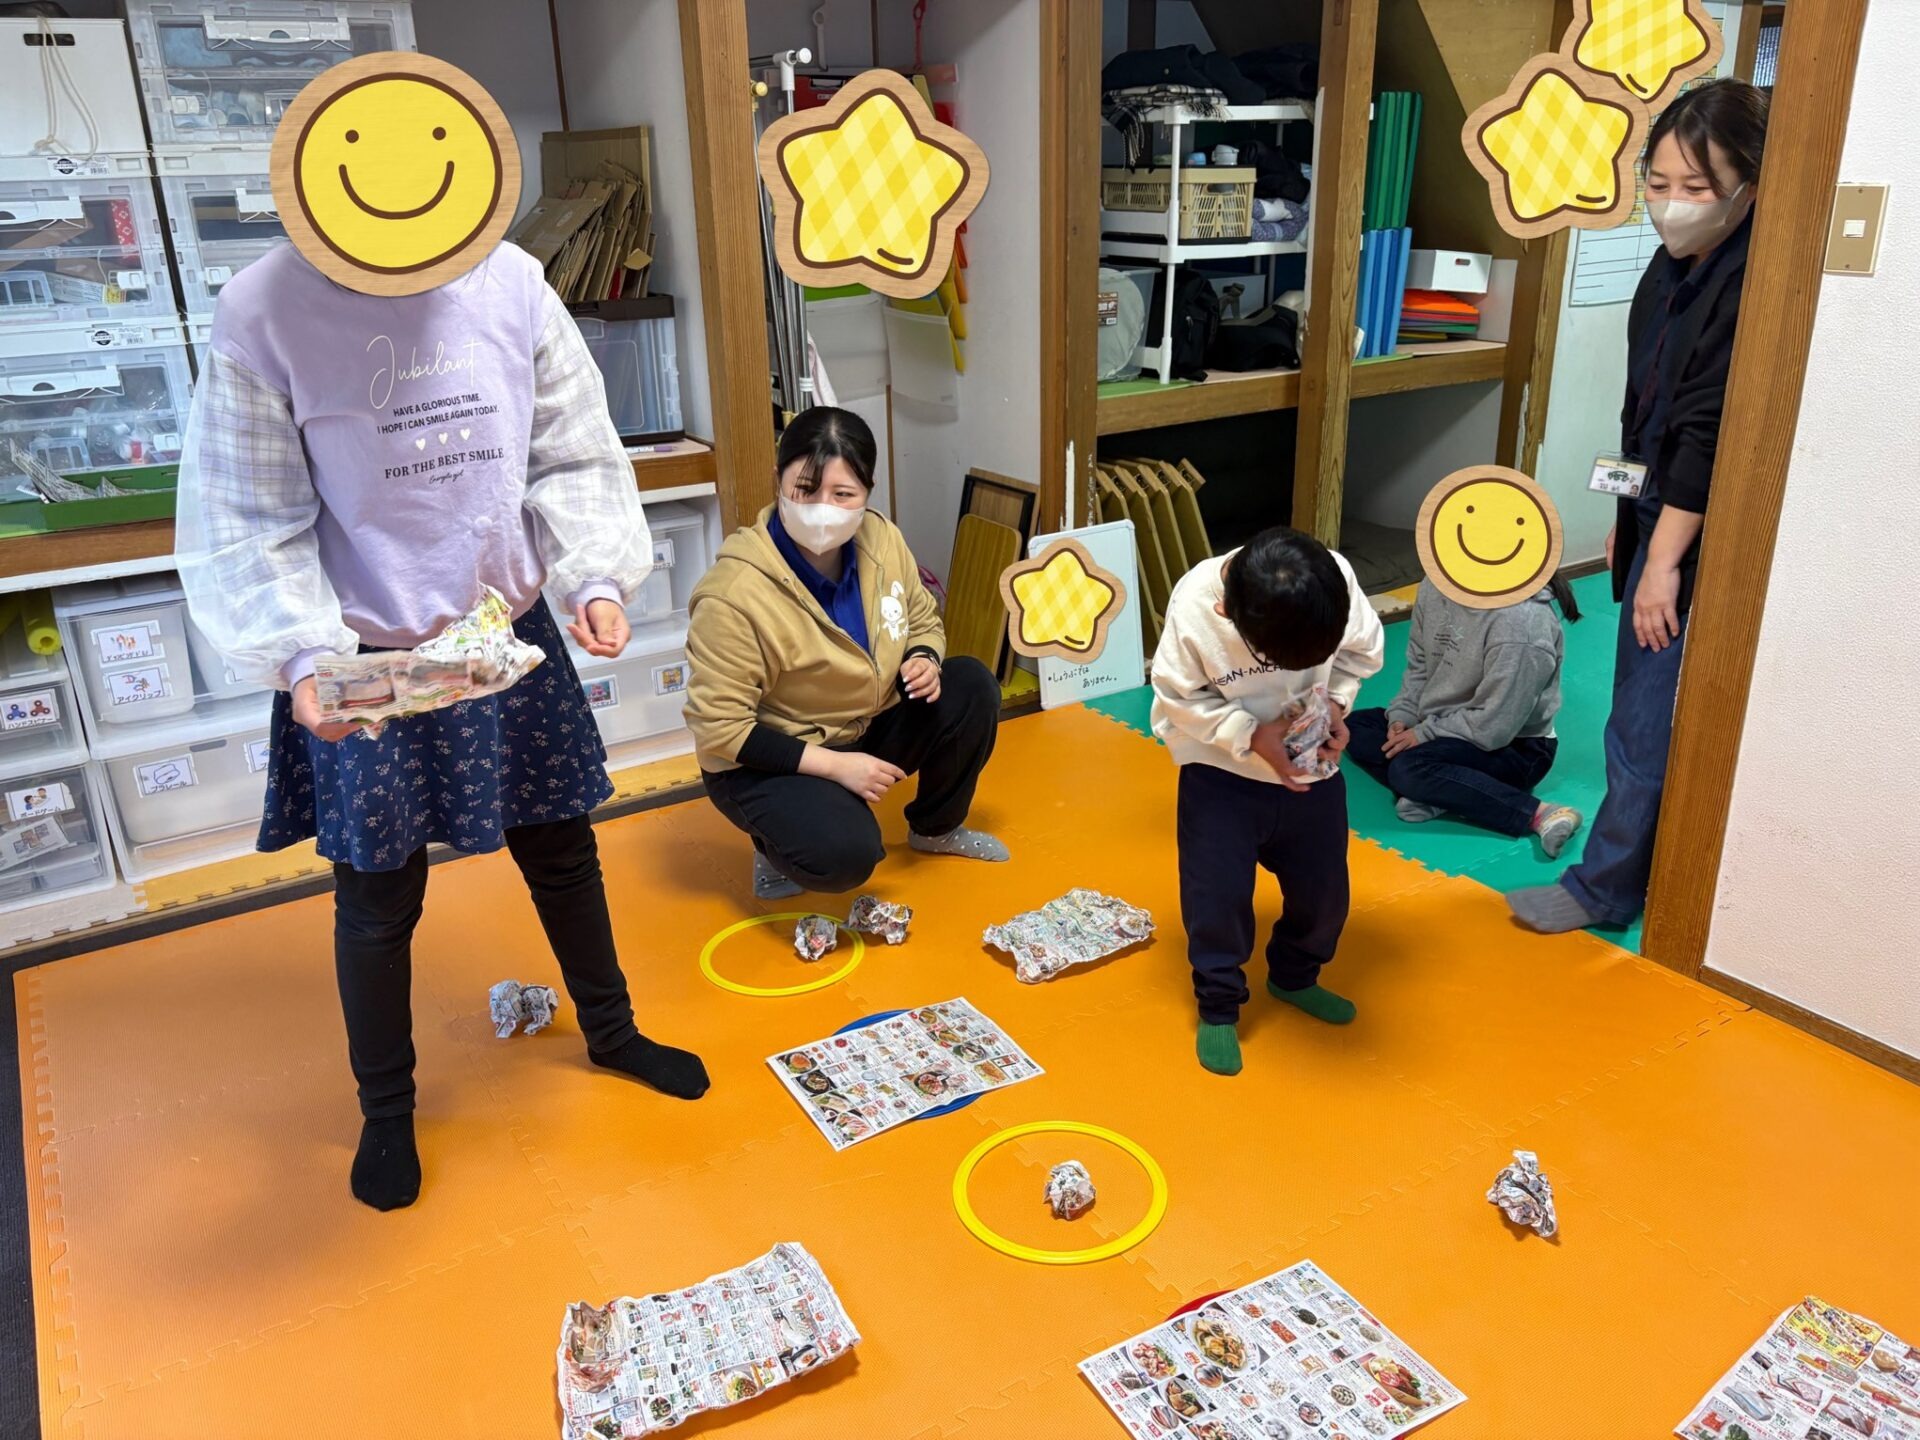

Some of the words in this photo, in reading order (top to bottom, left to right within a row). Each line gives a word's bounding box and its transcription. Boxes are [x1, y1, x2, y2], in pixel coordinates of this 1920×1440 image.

[367, 335, 483, 410] Jubilant
[381, 420, 404, 435] HOPE
[408, 417, 426, 431] CAN
[426, 411, 450, 426] SMILE
[450, 408, 474, 421] AGAIN
[474, 404, 500, 417] TODAY.
[393, 404, 415, 418] HAVE
[415, 404, 422, 414] A
[421, 395, 462, 413] GLORIOUS
[461, 392, 482, 405] TIME.
[384, 465, 411, 480] FOR
[412, 458, 436, 474] THE
[437, 451, 468, 468] BEST
[469, 447, 505, 464] SMILE
